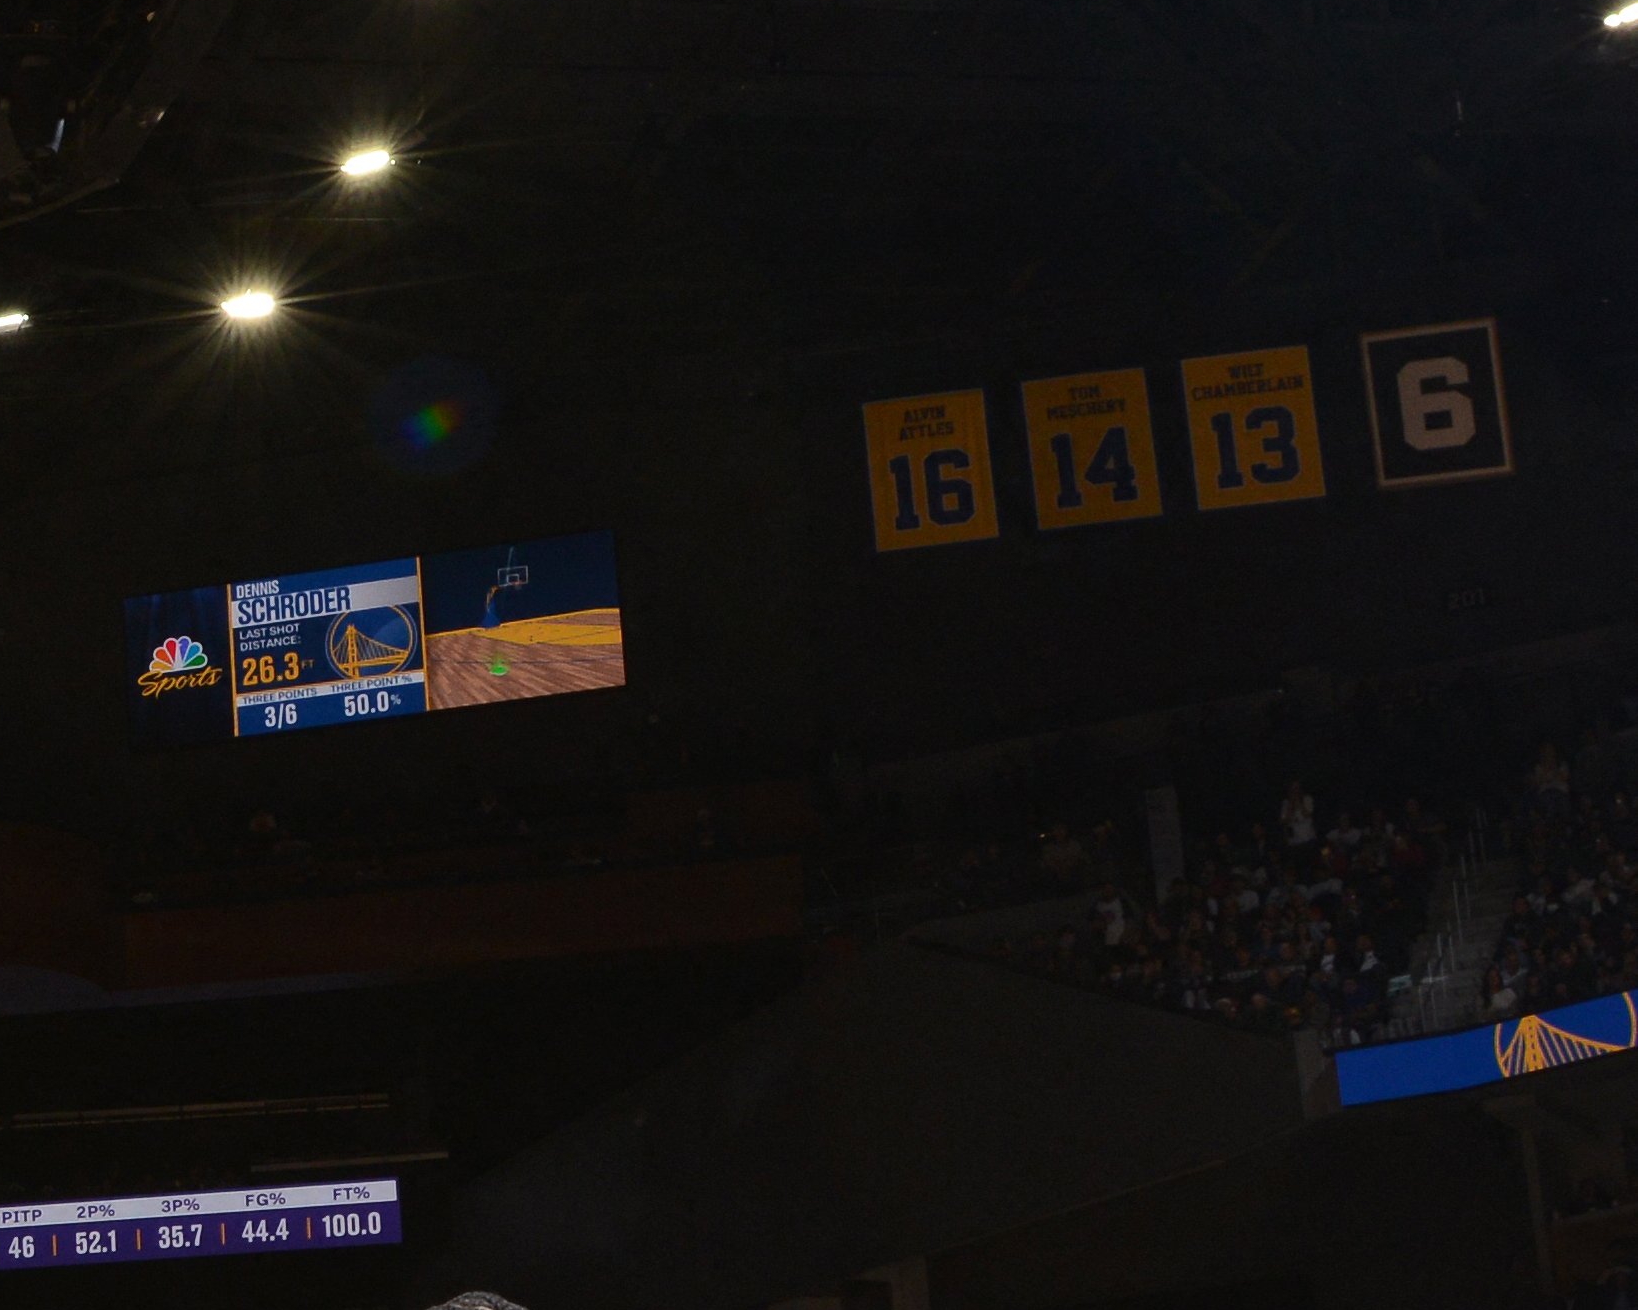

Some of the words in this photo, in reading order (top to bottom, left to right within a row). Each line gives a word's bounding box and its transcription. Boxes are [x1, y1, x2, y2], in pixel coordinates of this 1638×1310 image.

[1396, 356, 1476, 451] 6
[1210, 405, 1301, 489] 13
[1050, 427, 1139, 509] 14
[889, 448, 976, 530] 16
[236, 580, 279, 599] DENNIS
[237, 587, 352, 625] SCHRODER
[239, 628, 267, 640] LAST
[269, 623, 300, 637] SHOT
[240, 636, 302, 652] DISTANCE:
[137, 666, 222, 698] Sports
[242, 652, 300, 686] 26.3
[264, 703, 298, 729] 3/6
[344, 691, 402, 717] 50.0%
[2, 1209, 43, 1225] PITP
[76, 1204, 116, 1220] 2P%
[161, 1198, 201, 1214] 3P%
[245, 1191, 286, 1208] FG%
[332, 1186, 371, 1203] FT%
[8, 1236, 35, 1260] 46
[75, 1230, 117, 1256] 52.1
[158, 1224, 203, 1250] 35.7
[241, 1217, 289, 1245] 44.4
[322, 1211, 381, 1238] 100.0
